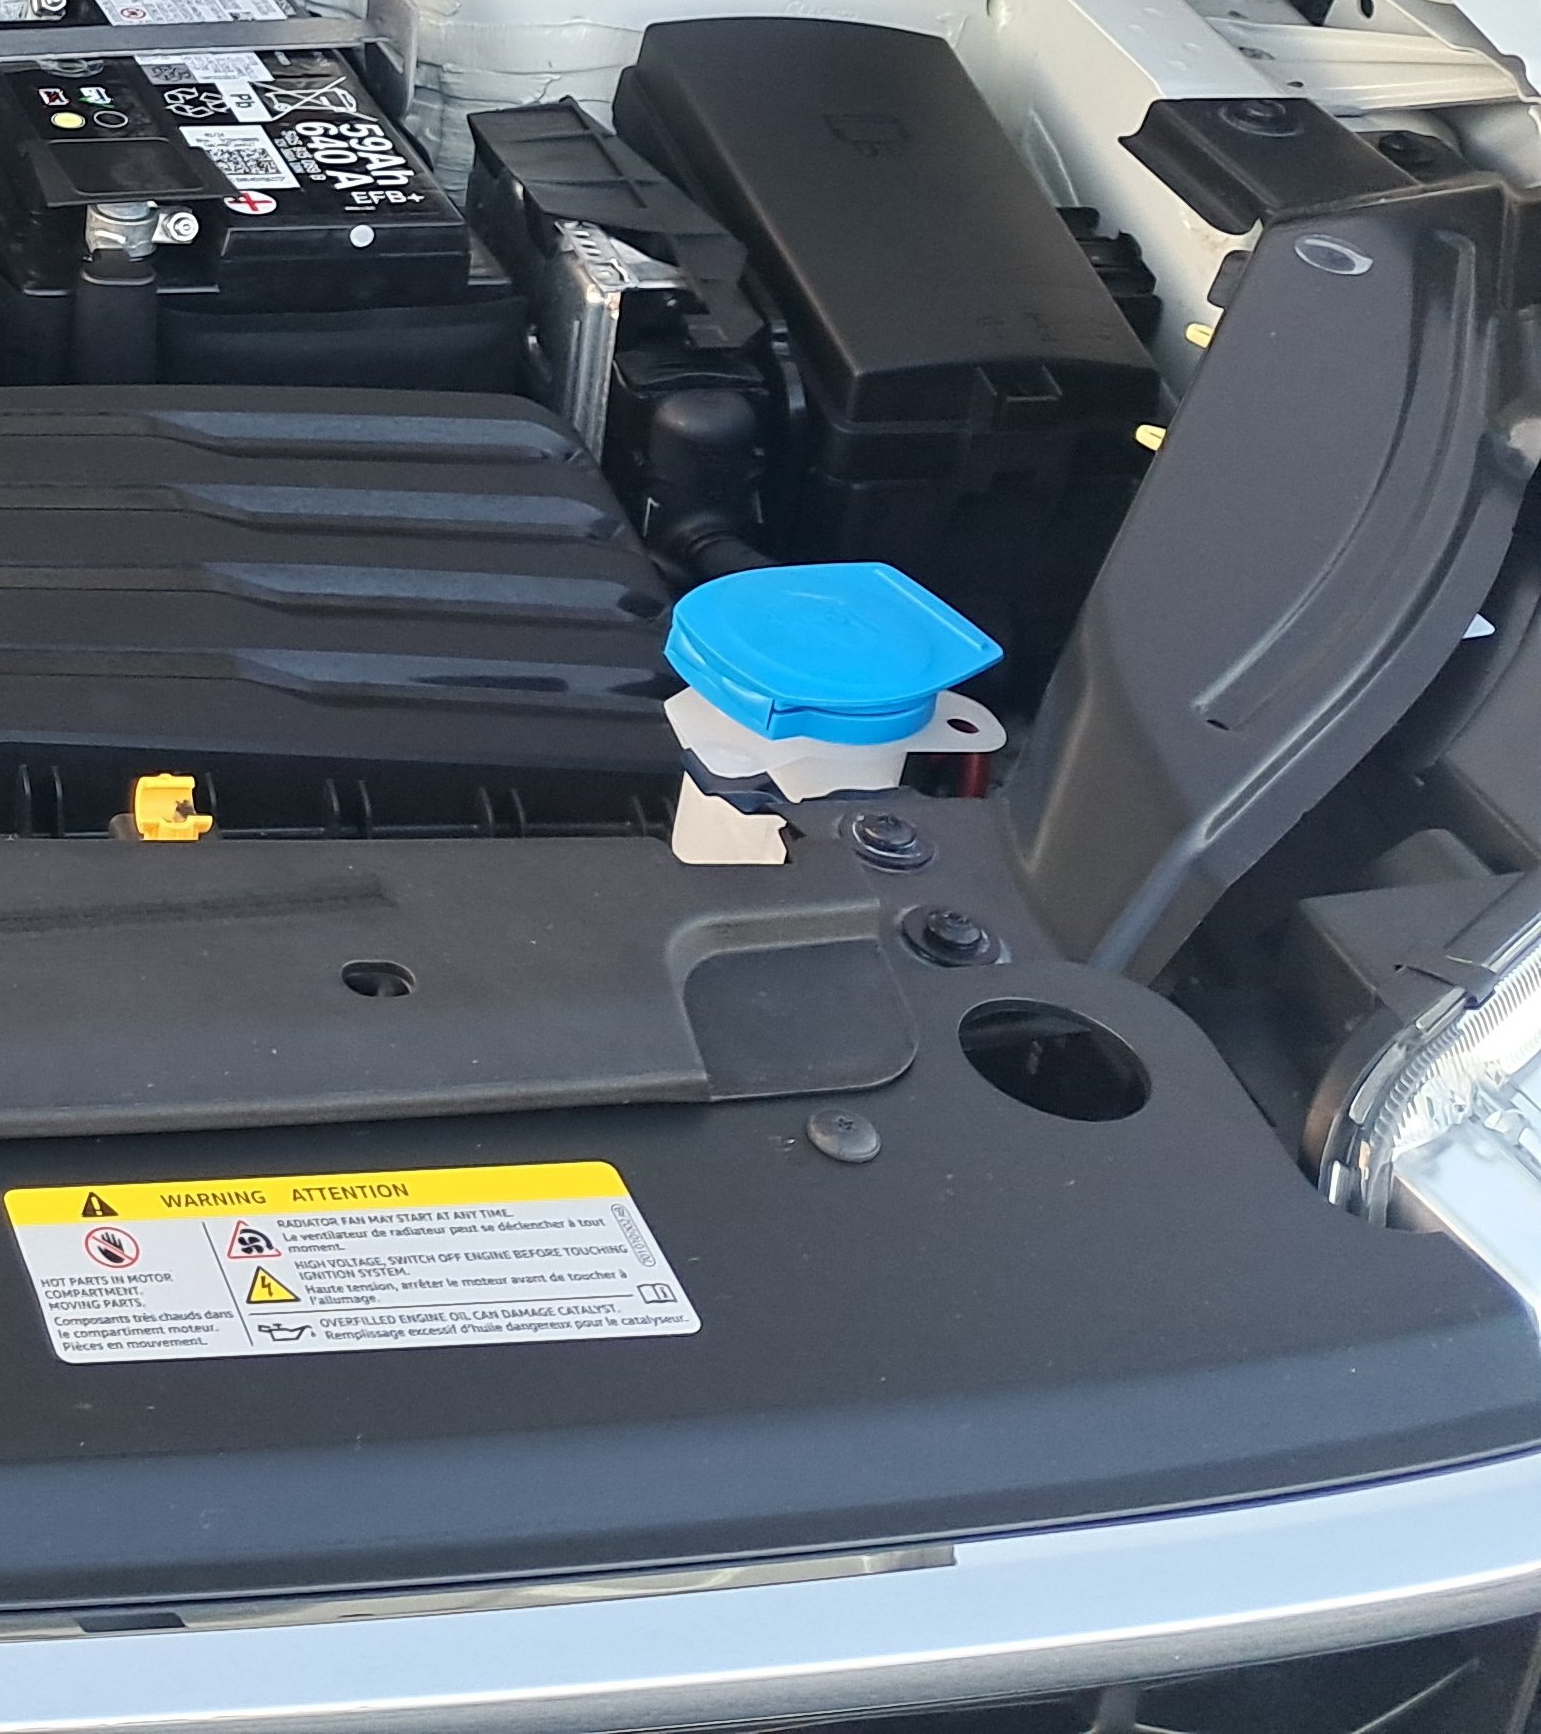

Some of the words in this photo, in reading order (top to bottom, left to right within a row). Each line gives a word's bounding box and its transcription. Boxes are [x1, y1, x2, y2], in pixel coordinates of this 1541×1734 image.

[230, 93, 253, 108] Pb
[295, 121, 357, 164] 640
[339, 122, 415, 187] 59Ah
[324, 170, 375, 189] A
[350, 190, 425, 204] EFB+
[159, 1190, 267, 1208] WARNING
[292, 1183, 410, 1202] ATTENTION
[277, 1216, 338, 1228] RADIATOR
[340, 1215, 366, 1226] FAN
[368, 1214, 395, 1225] MAY
[397, 1212, 433, 1223] START
[435, 1211, 450, 1221] AT
[453, 1209, 477, 1220] ANY
[282, 1232, 298, 1242] Le
[300, 1228, 368, 1241] ventilateur
[371, 1227, 387, 1238] de
[389, 1225, 447, 1236] radiateur
[449, 1224, 478, 1236] peut
[481, 1223, 496, 1232] se
[568, 1218, 576, 1228] à
[578, 1217, 606, 1227] tout
[293, 1259, 326, 1270] HIGH
[388, 1253, 436, 1266] SWITCH
[438, 1252, 462, 1264] OFF
[466, 1249, 512, 1262] ENGINE
[513, 1246, 562, 1259] BEFORE
[565, 1243, 629, 1257] TOUCHING
[40, 1277, 66, 1288] HOT
[69, 1275, 109, 1286] PARTS
[110, 1275, 125, 1285] IN
[127, 1273, 173, 1284] MOTOR
[299, 1269, 356, 1280] IGNITION
[305, 1283, 345, 1295] Haute
[446, 1277, 458, 1288] le
[462, 1275, 508, 1286] moteur
[510, 1273, 547, 1284] avant
[549, 1271, 565, 1282] de
[567, 1269, 617, 1281] toucher
[619, 1268, 628, 1279] à
[48, 1300, 102, 1311] MOVING
[54, 1314, 131, 1328] Composants
[133, 1312, 156, 1323] très
[158, 1310, 202, 1322] chauds
[204, 1309, 234, 1320] dans
[320, 1315, 397, 1328] OVERFILLED
[399, 1313, 447, 1324] ENGINE
[449, 1311, 471, 1322] OIL
[472, 1310, 500, 1321] CAN
[501, 1307, 556, 1320] DAMAGE
[58, 1329, 70, 1339] le
[73, 1326, 166, 1339] compartiment
[325, 1326, 407, 1341] Remplissage
[408, 1324, 457, 1337] excessif
[505, 1319, 573, 1333] dangereux
[574, 1318, 604, 1330] pour
[606, 1316, 618, 1327] le
[62, 1341, 103, 1353] Pièces
[107, 1341, 124, 1350] en
